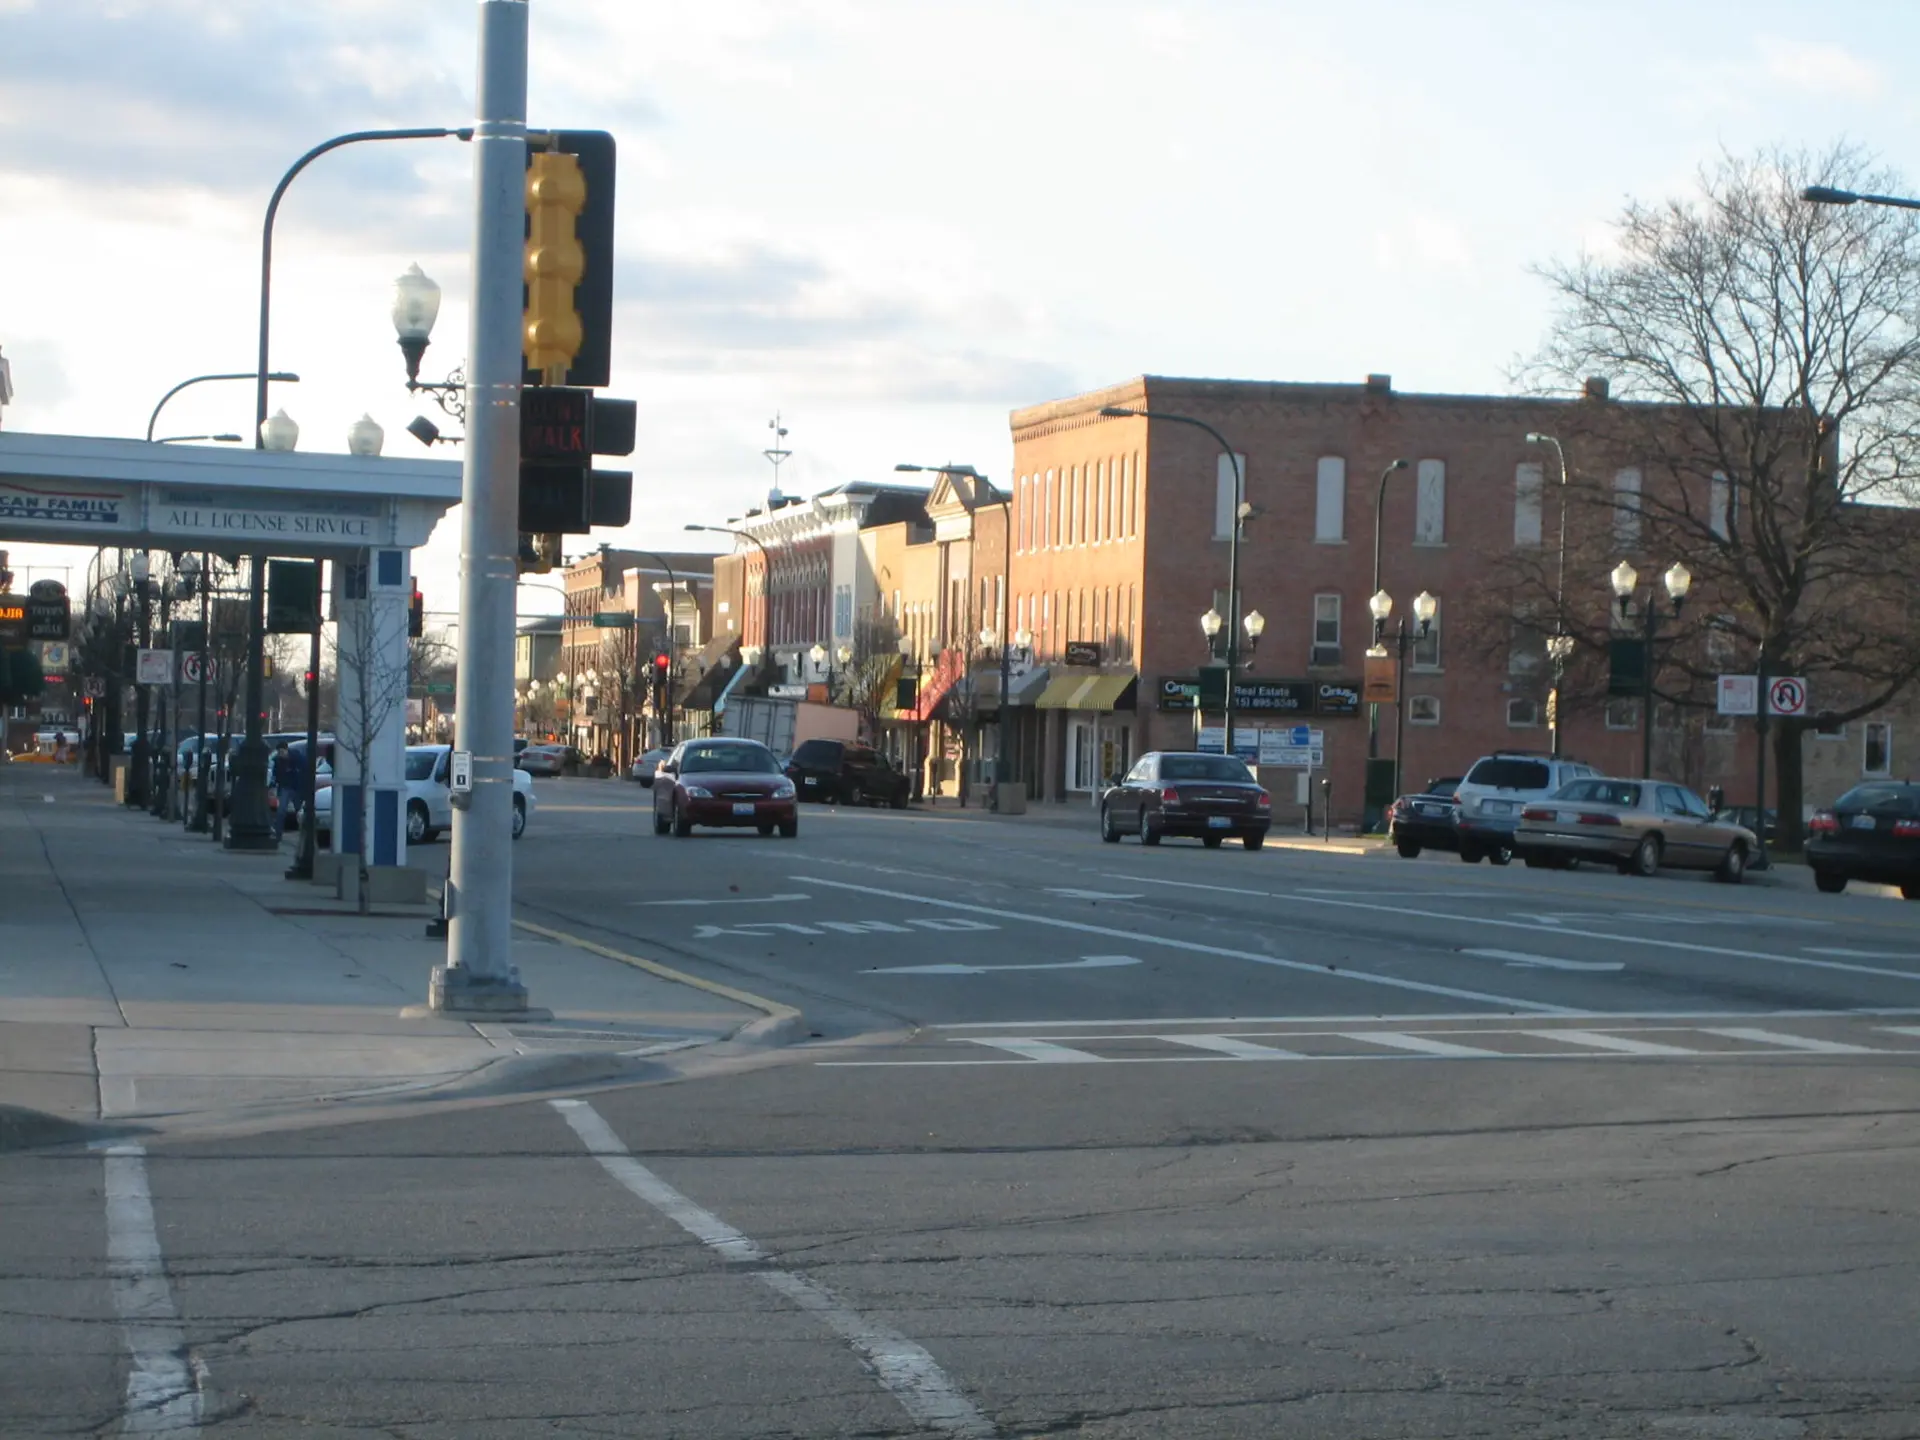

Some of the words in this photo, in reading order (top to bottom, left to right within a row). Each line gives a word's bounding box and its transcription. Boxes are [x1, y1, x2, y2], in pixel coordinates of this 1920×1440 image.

[48, 498, 119, 512] FAMILY
[168, 510, 205, 528] ALL
[211, 512, 290, 532] LICENSE
[294, 516, 371, 536] SERVICE
[1234, 686, 1256, 696] Real
[1259, 686, 1290, 697] Estate
[692, 917, 1002, 938] ONLY
